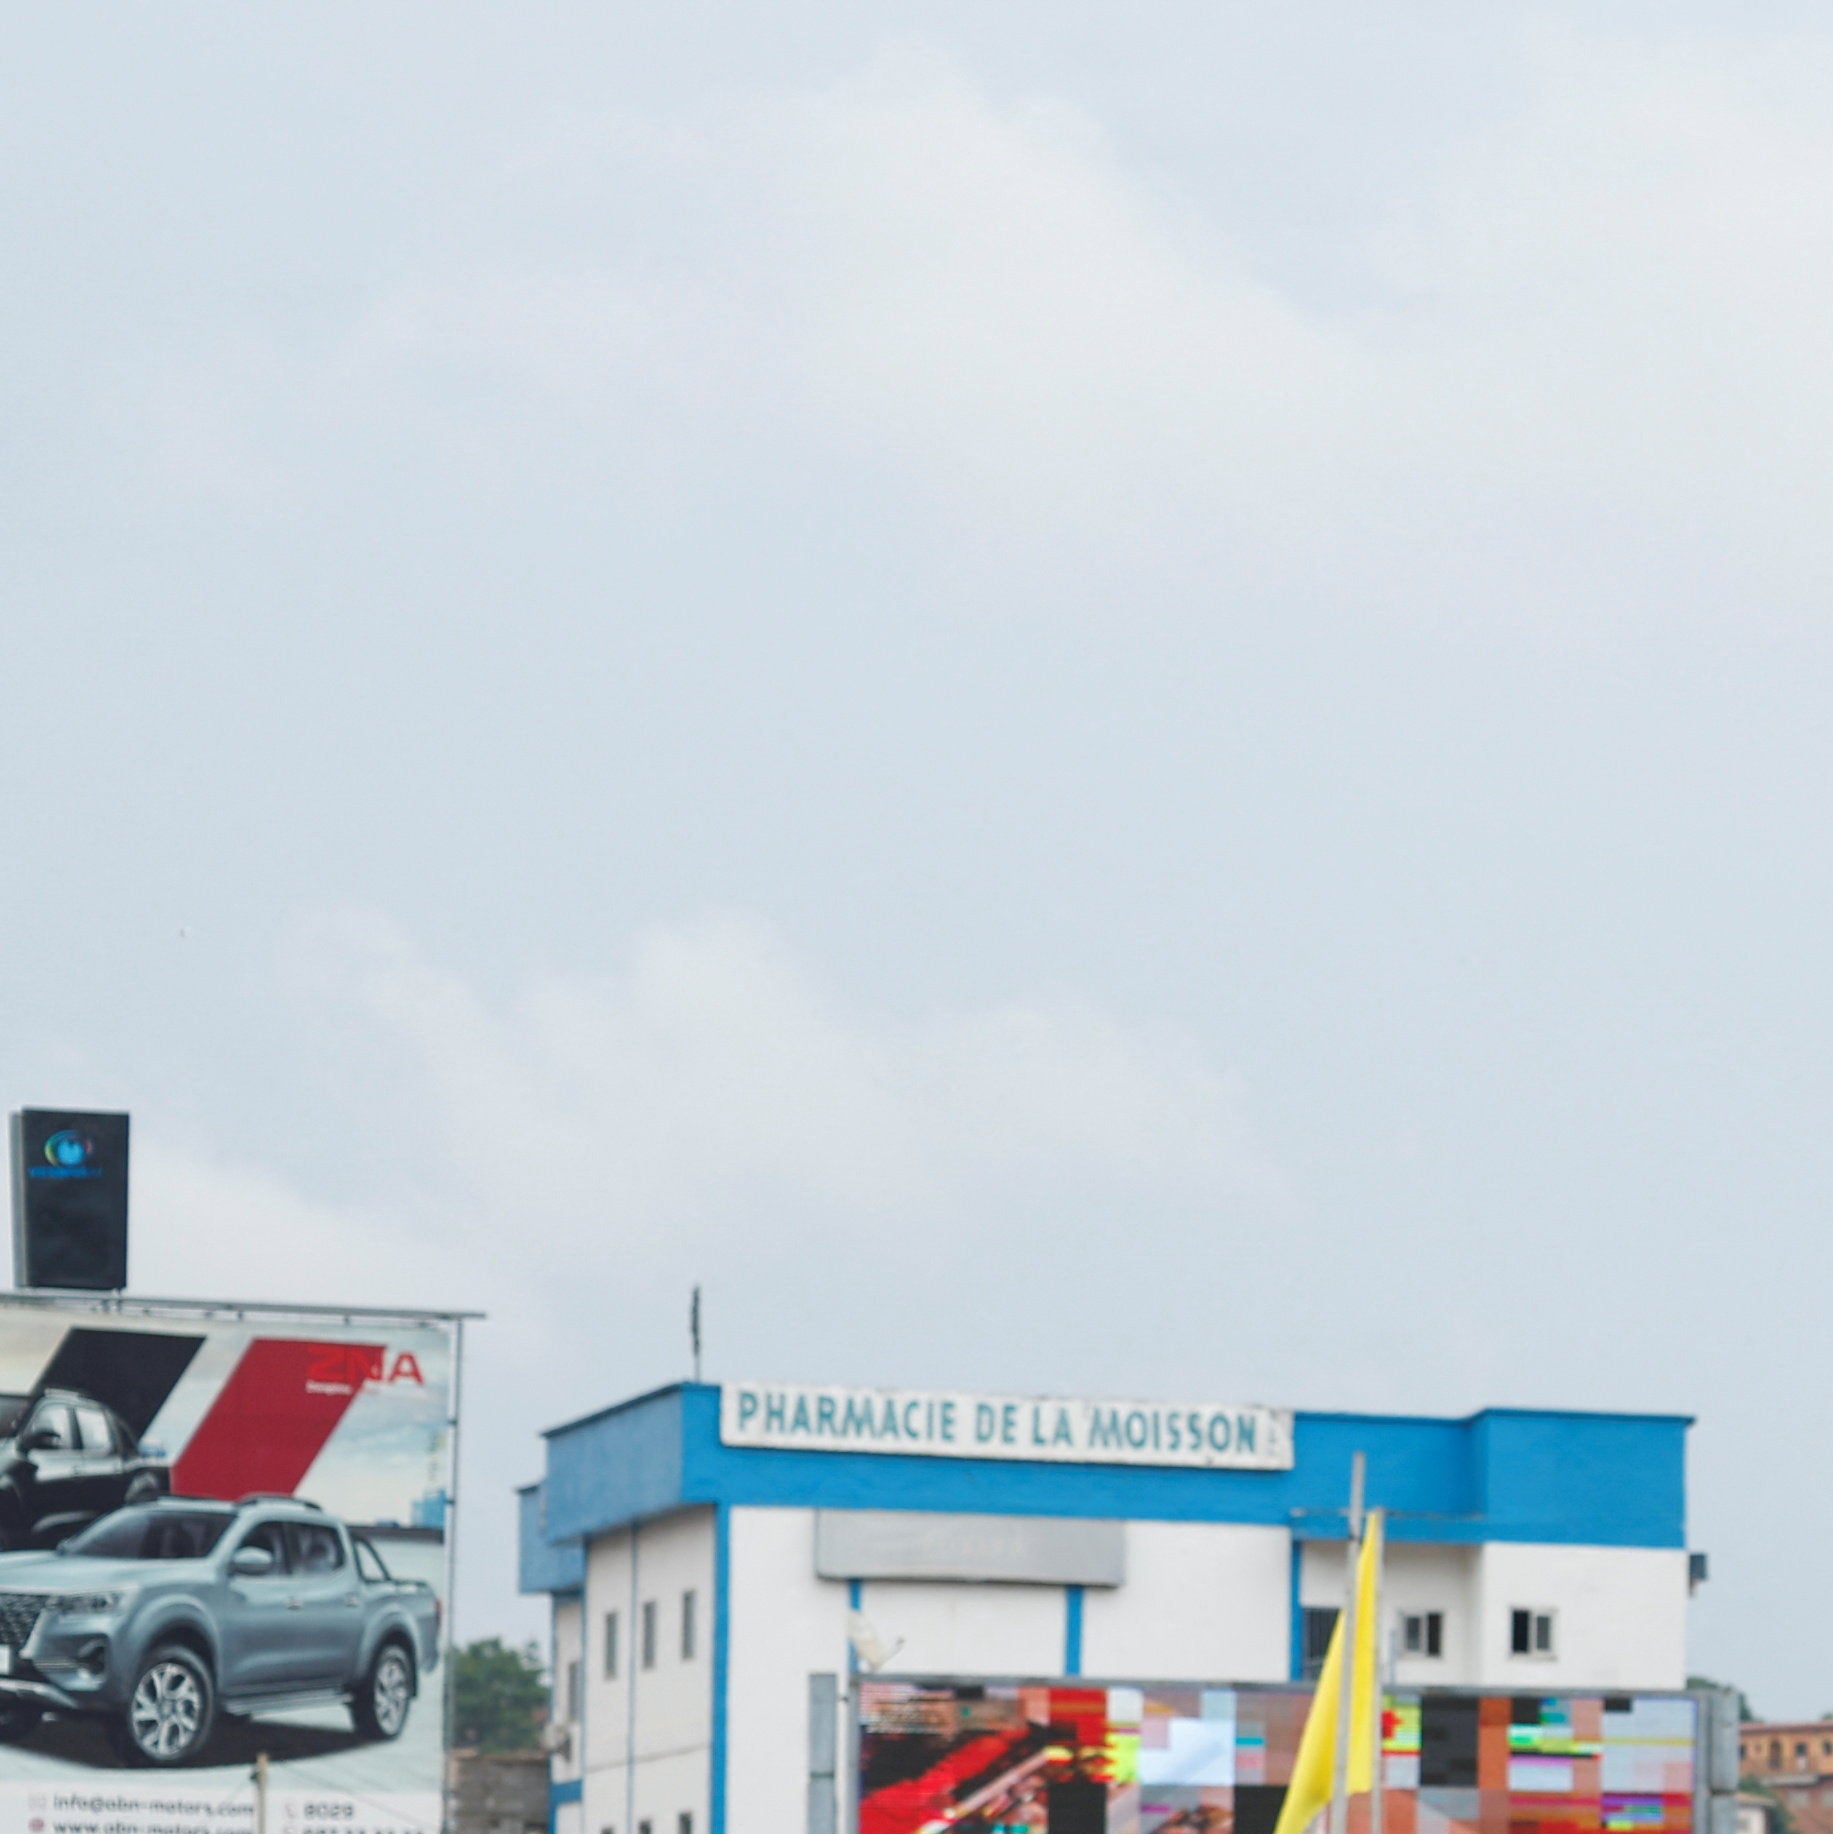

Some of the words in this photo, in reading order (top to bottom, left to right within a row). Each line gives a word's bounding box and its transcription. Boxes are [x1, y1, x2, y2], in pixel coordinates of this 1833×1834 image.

[737, 1391, 956, 1442] PHARMACIE
[975, 1403, 1016, 1444] DE
[1032, 1405, 1073, 1448] LA
[1088, 1408, 1257, 1454] MOISSON
